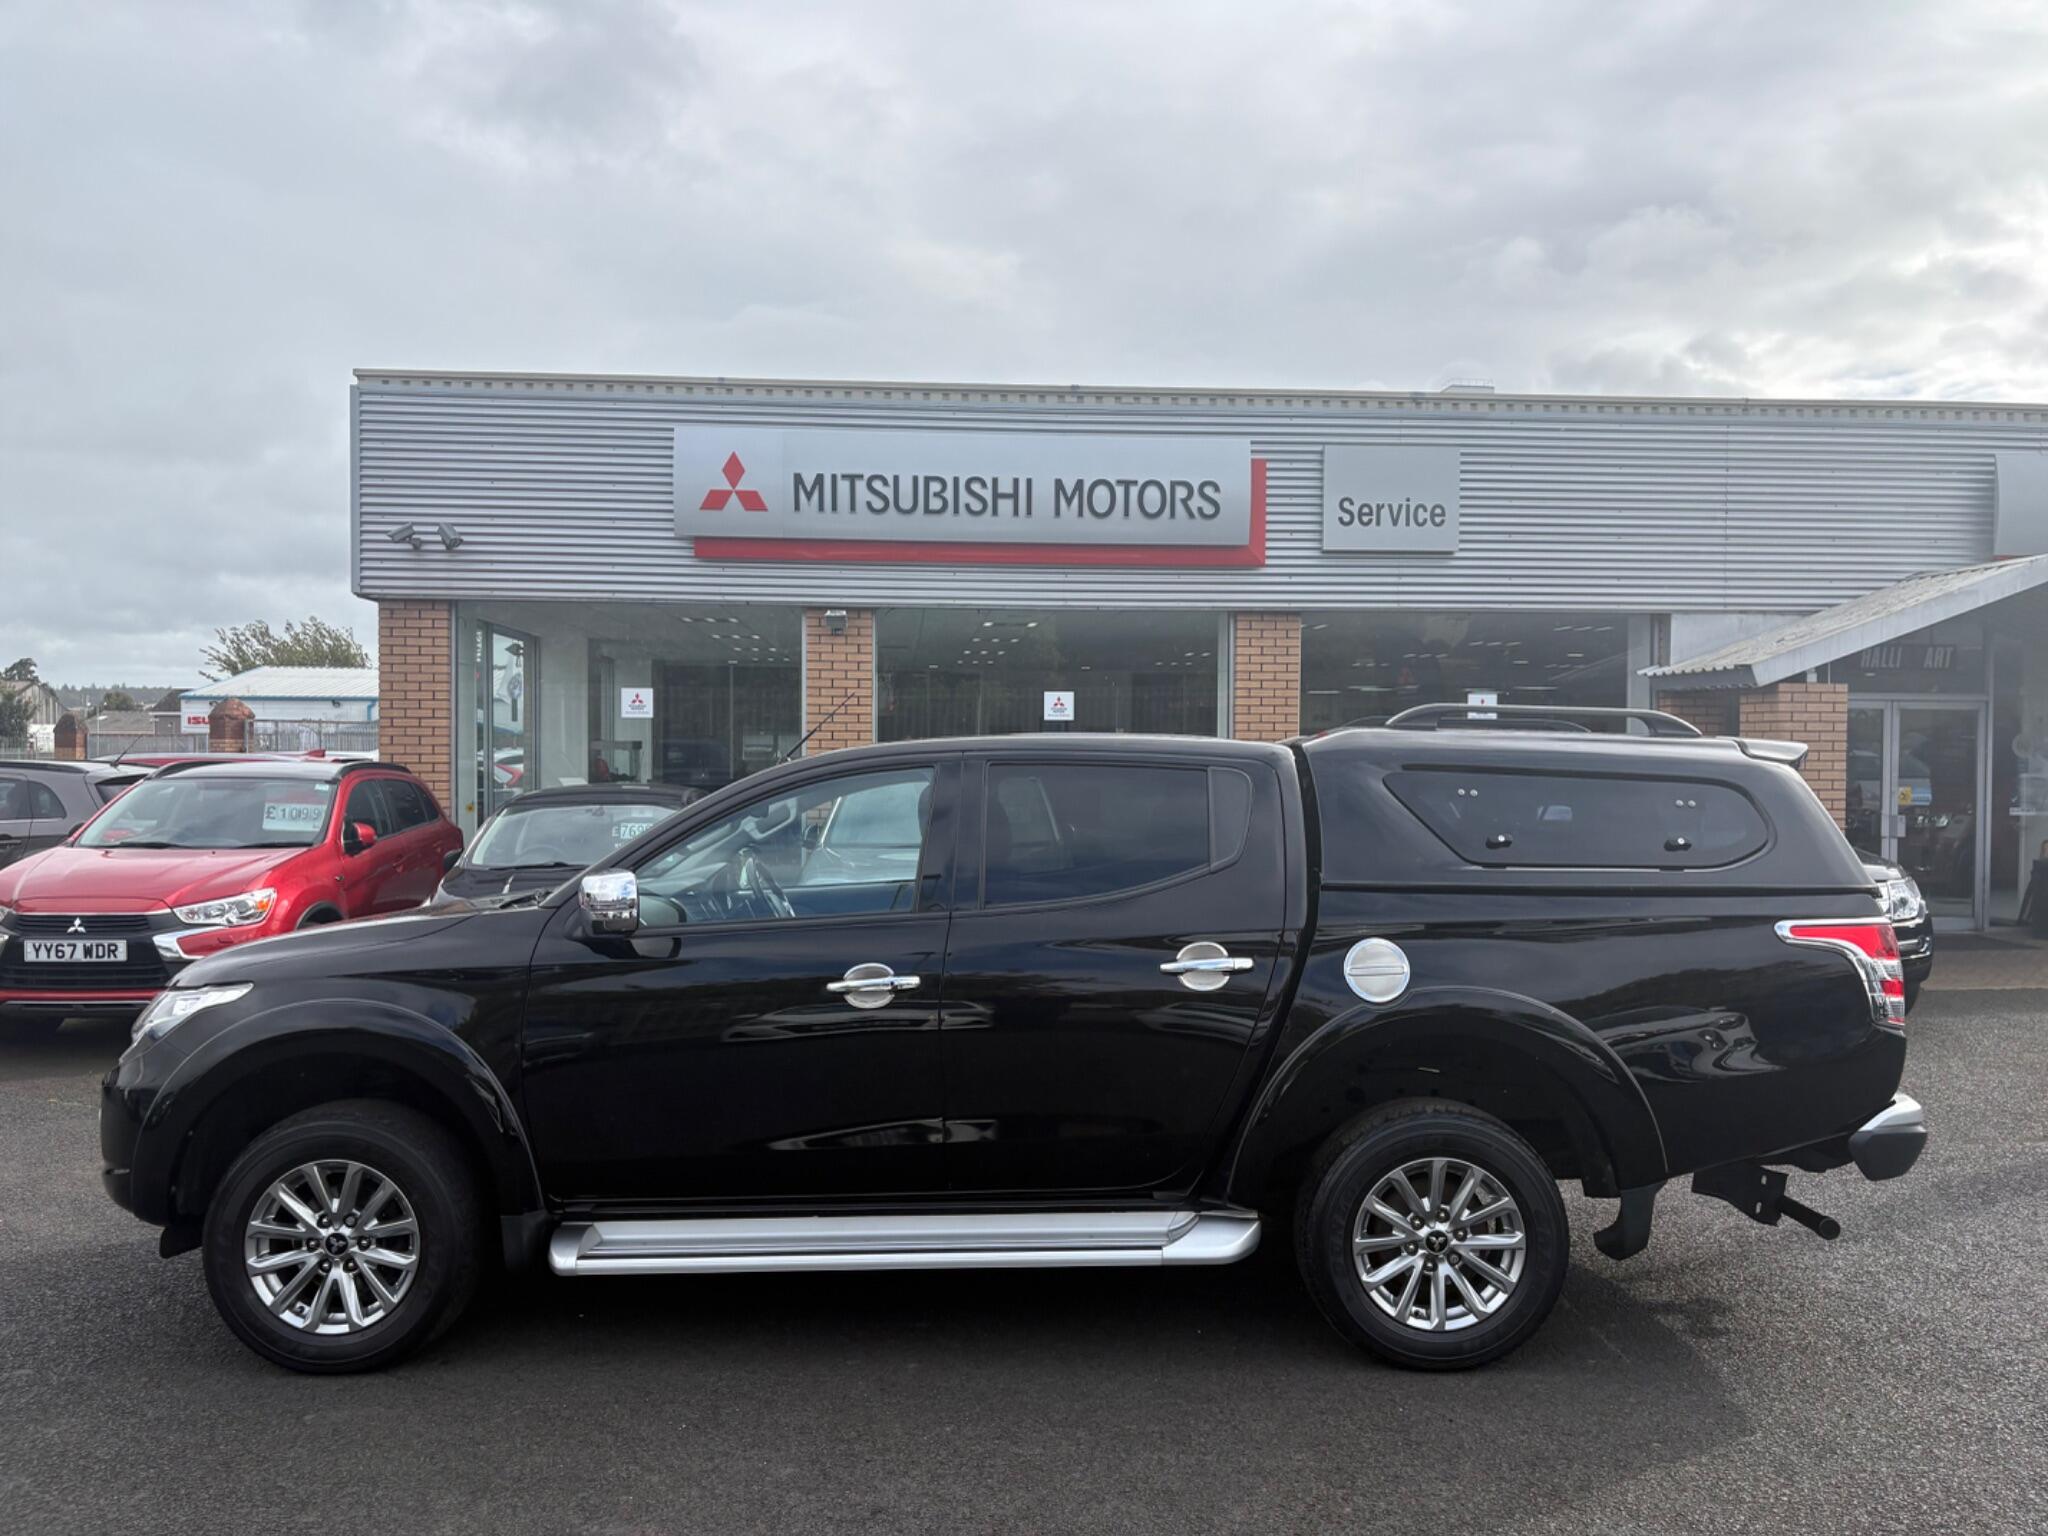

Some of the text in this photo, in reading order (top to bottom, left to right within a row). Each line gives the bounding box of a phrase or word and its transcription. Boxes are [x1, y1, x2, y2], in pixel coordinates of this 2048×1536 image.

[793, 472, 1221, 520] MITSUBISHI MOTORS
[1337, 496, 1447, 528] Service
[32, 943, 119, 960] YY67 WDR
